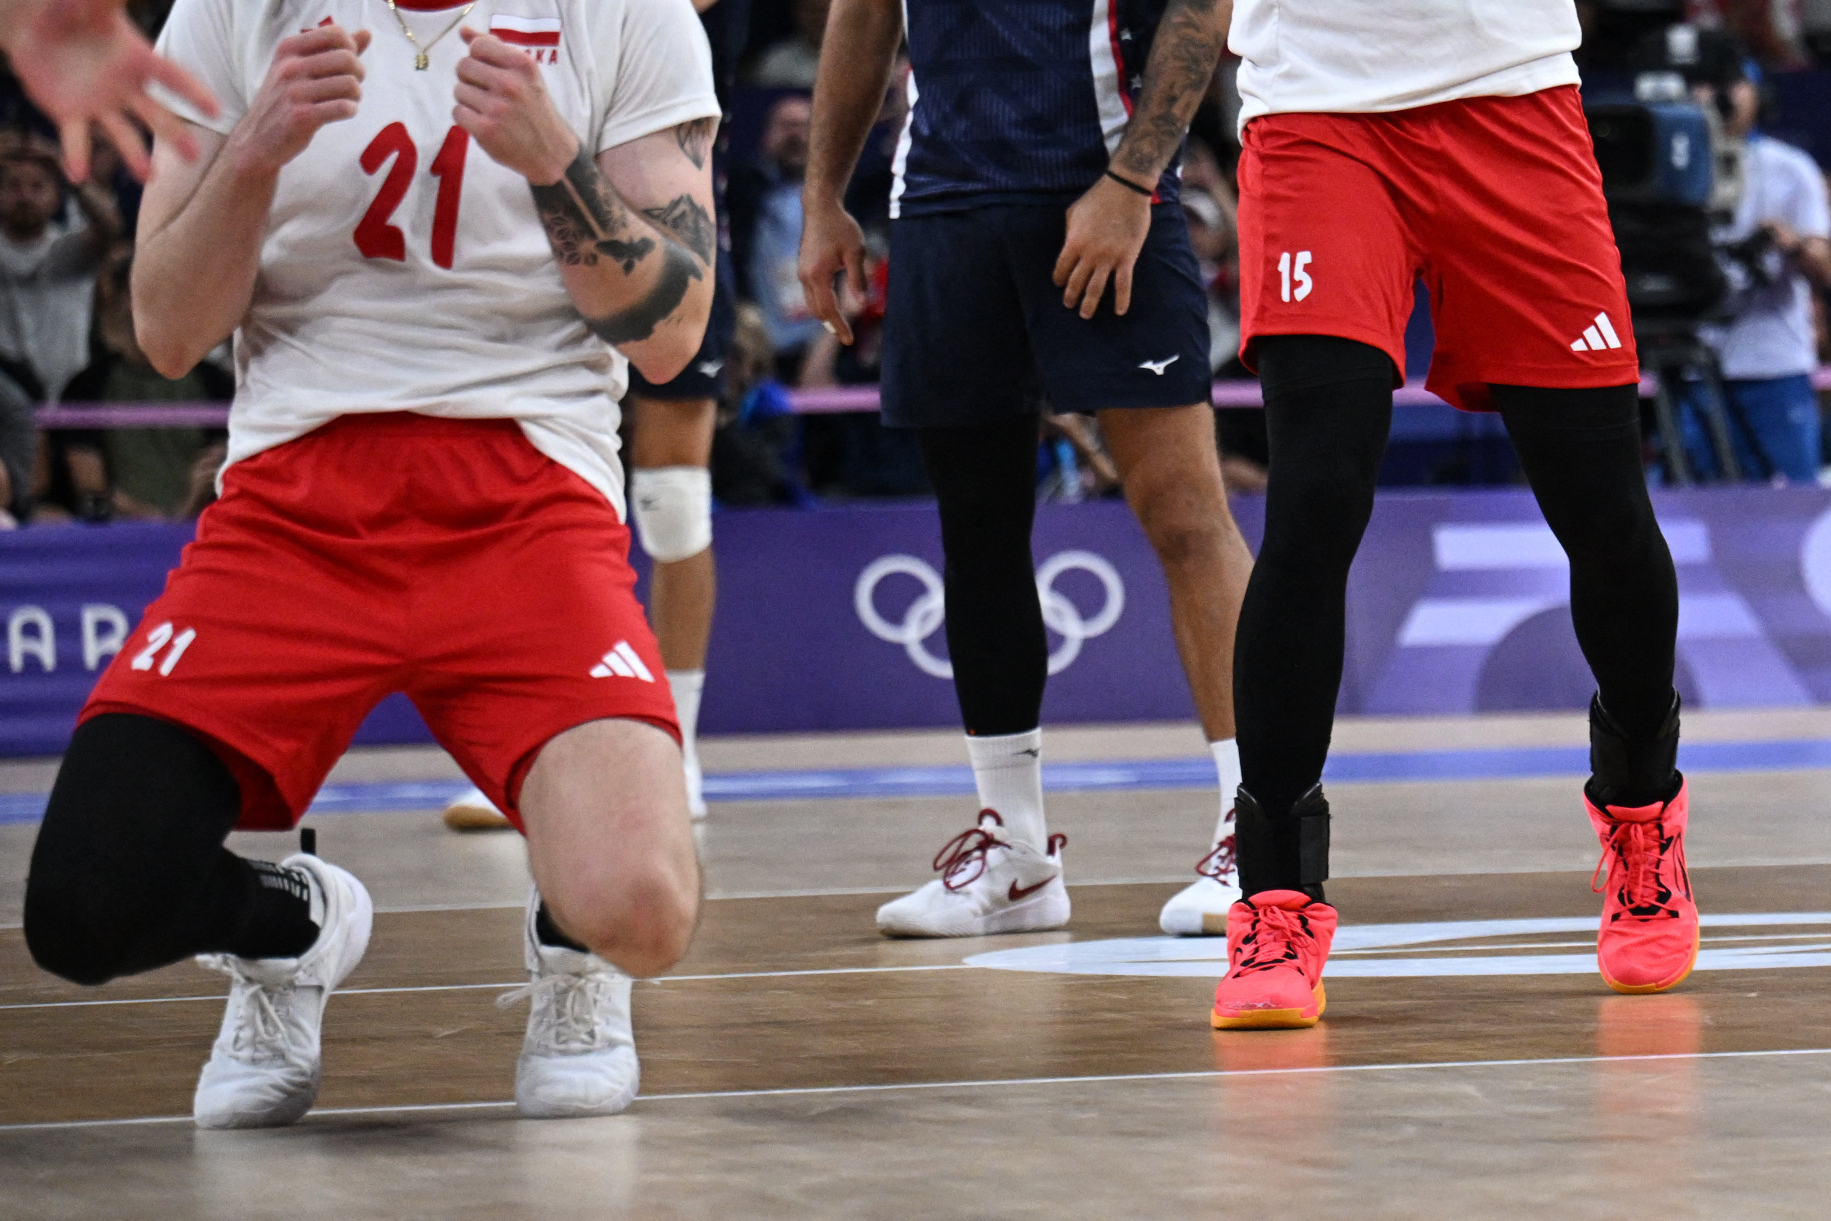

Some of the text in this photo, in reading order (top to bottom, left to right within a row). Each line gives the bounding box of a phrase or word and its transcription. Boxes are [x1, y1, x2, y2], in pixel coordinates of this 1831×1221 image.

[353, 121, 470, 270] 21
[1278, 251, 1312, 302] 15
[131, 622, 196, 677] 21
